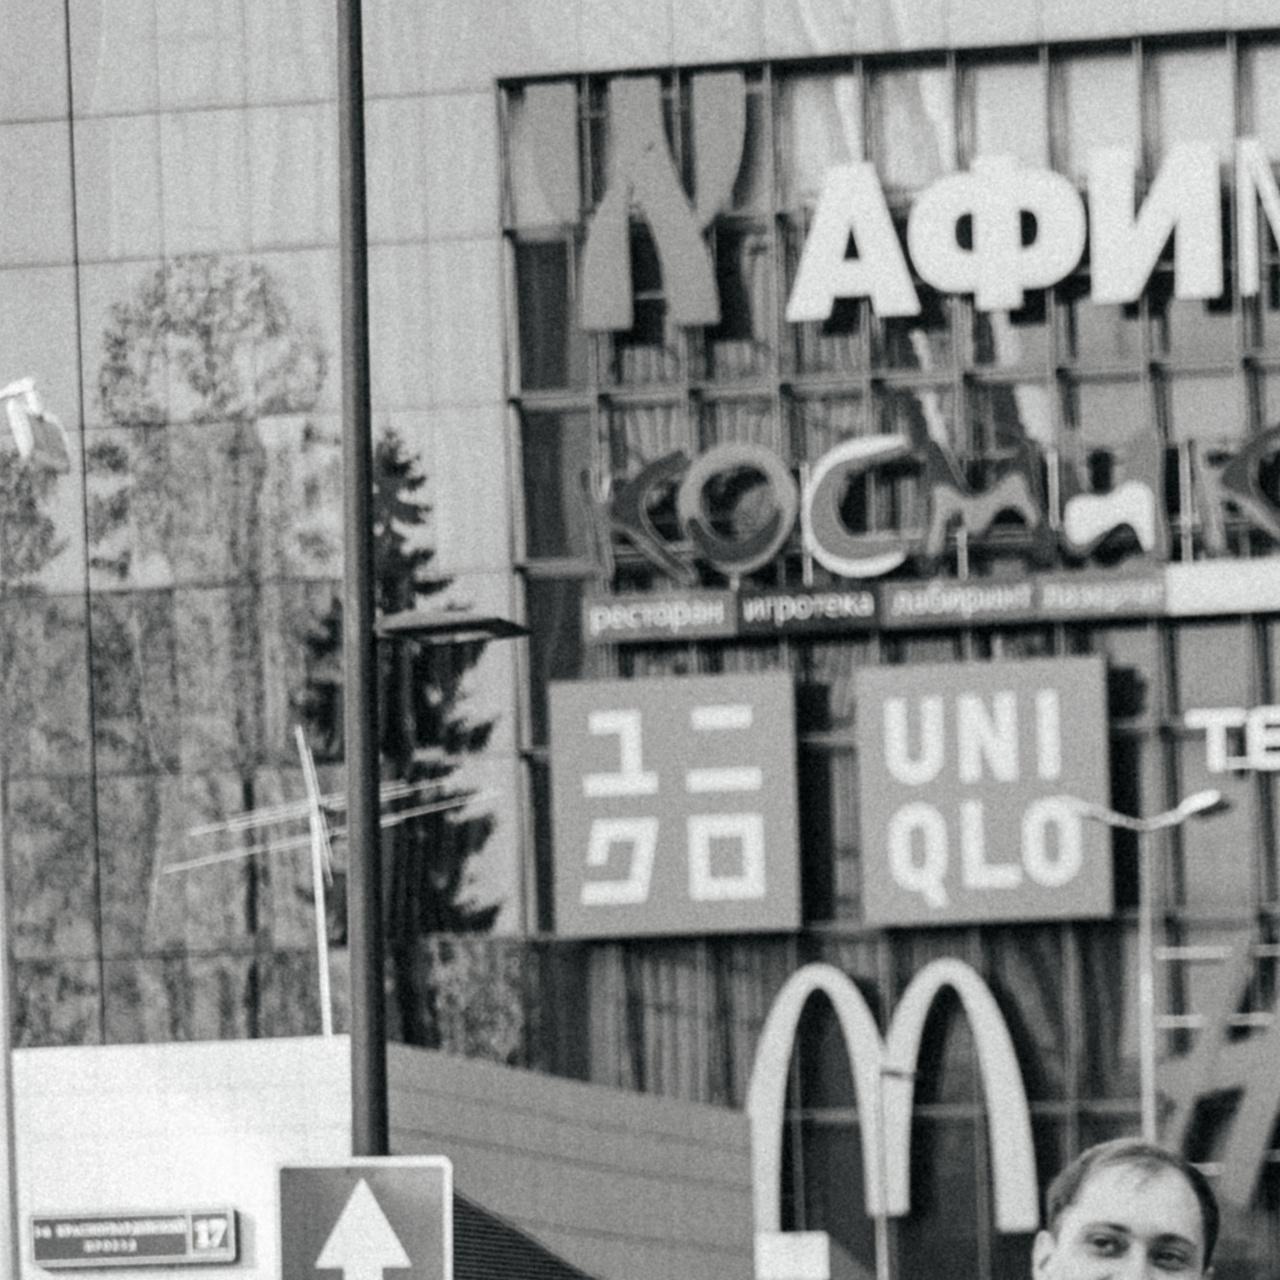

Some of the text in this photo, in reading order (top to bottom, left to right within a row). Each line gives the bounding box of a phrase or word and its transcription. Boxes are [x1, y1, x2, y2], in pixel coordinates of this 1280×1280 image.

[882, 688, 1062, 786] UNI
[886, 796, 1084, 910] QLO
[195, 1217, 227, 1249] 17
